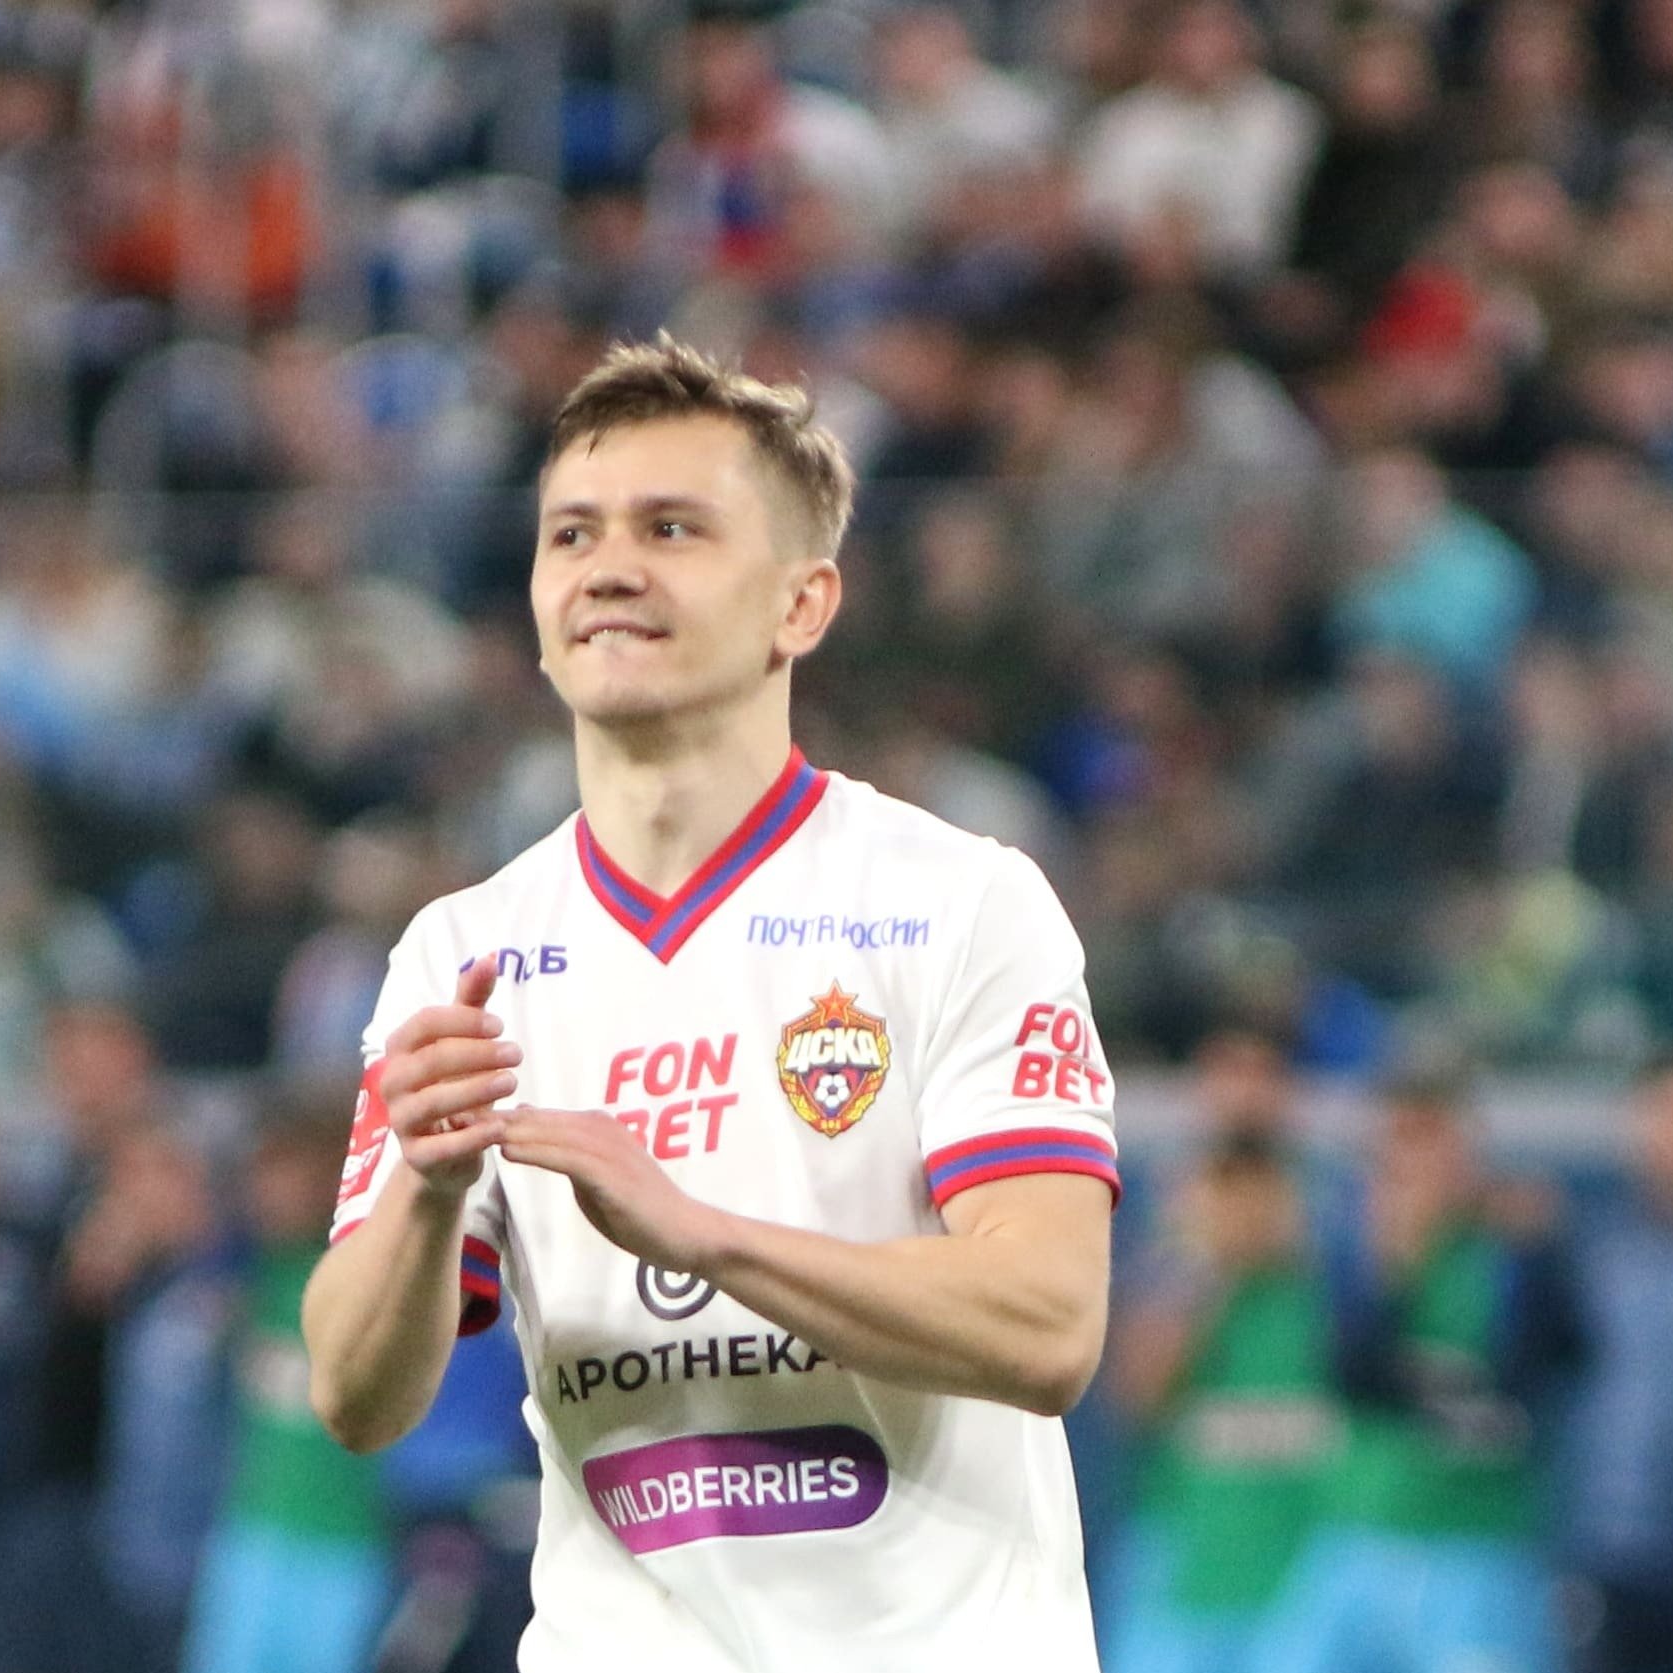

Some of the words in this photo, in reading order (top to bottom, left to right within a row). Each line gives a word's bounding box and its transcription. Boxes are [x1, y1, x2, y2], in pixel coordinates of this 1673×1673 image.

[604, 1032, 739, 1105] FON
[785, 1026, 883, 1074] ЦСКА
[1011, 1050, 1106, 1105] BET
[614, 1093, 739, 1161] BET
[597, 1456, 860, 1528] WILDBERRIES
